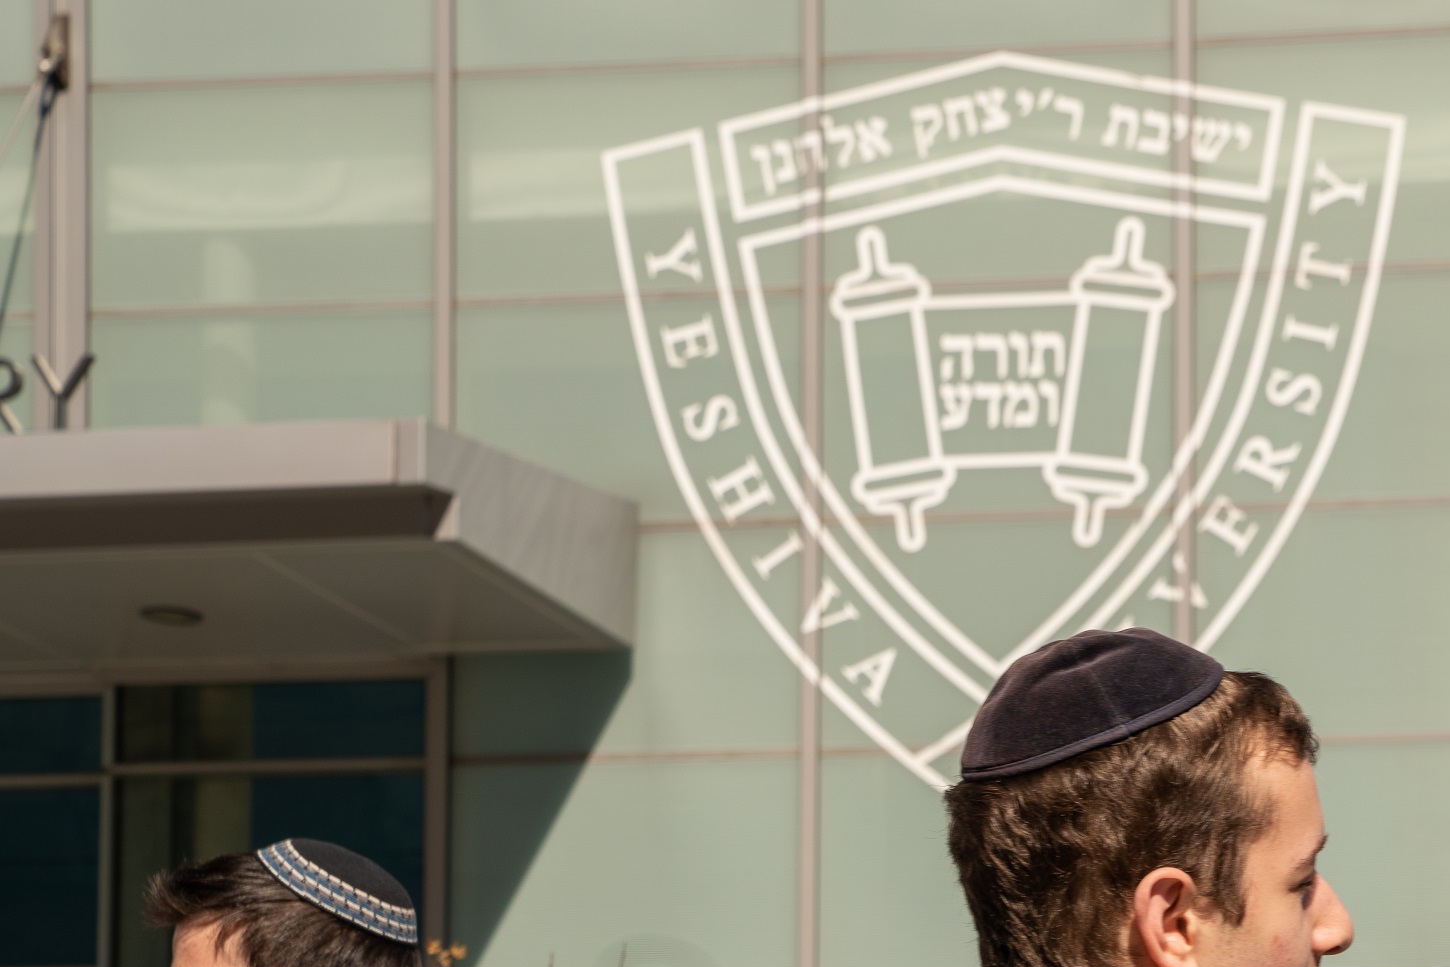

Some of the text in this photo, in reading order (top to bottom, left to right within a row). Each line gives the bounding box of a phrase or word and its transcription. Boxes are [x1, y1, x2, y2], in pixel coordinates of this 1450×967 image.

[1100, 102, 1253, 164] ישיבת
[939, 329, 1066, 382] תורה
[939, 378, 1060, 431] ומדע
[1112, 159, 1368, 633] VERSITY
[645, 228, 897, 707] YESHIVA
